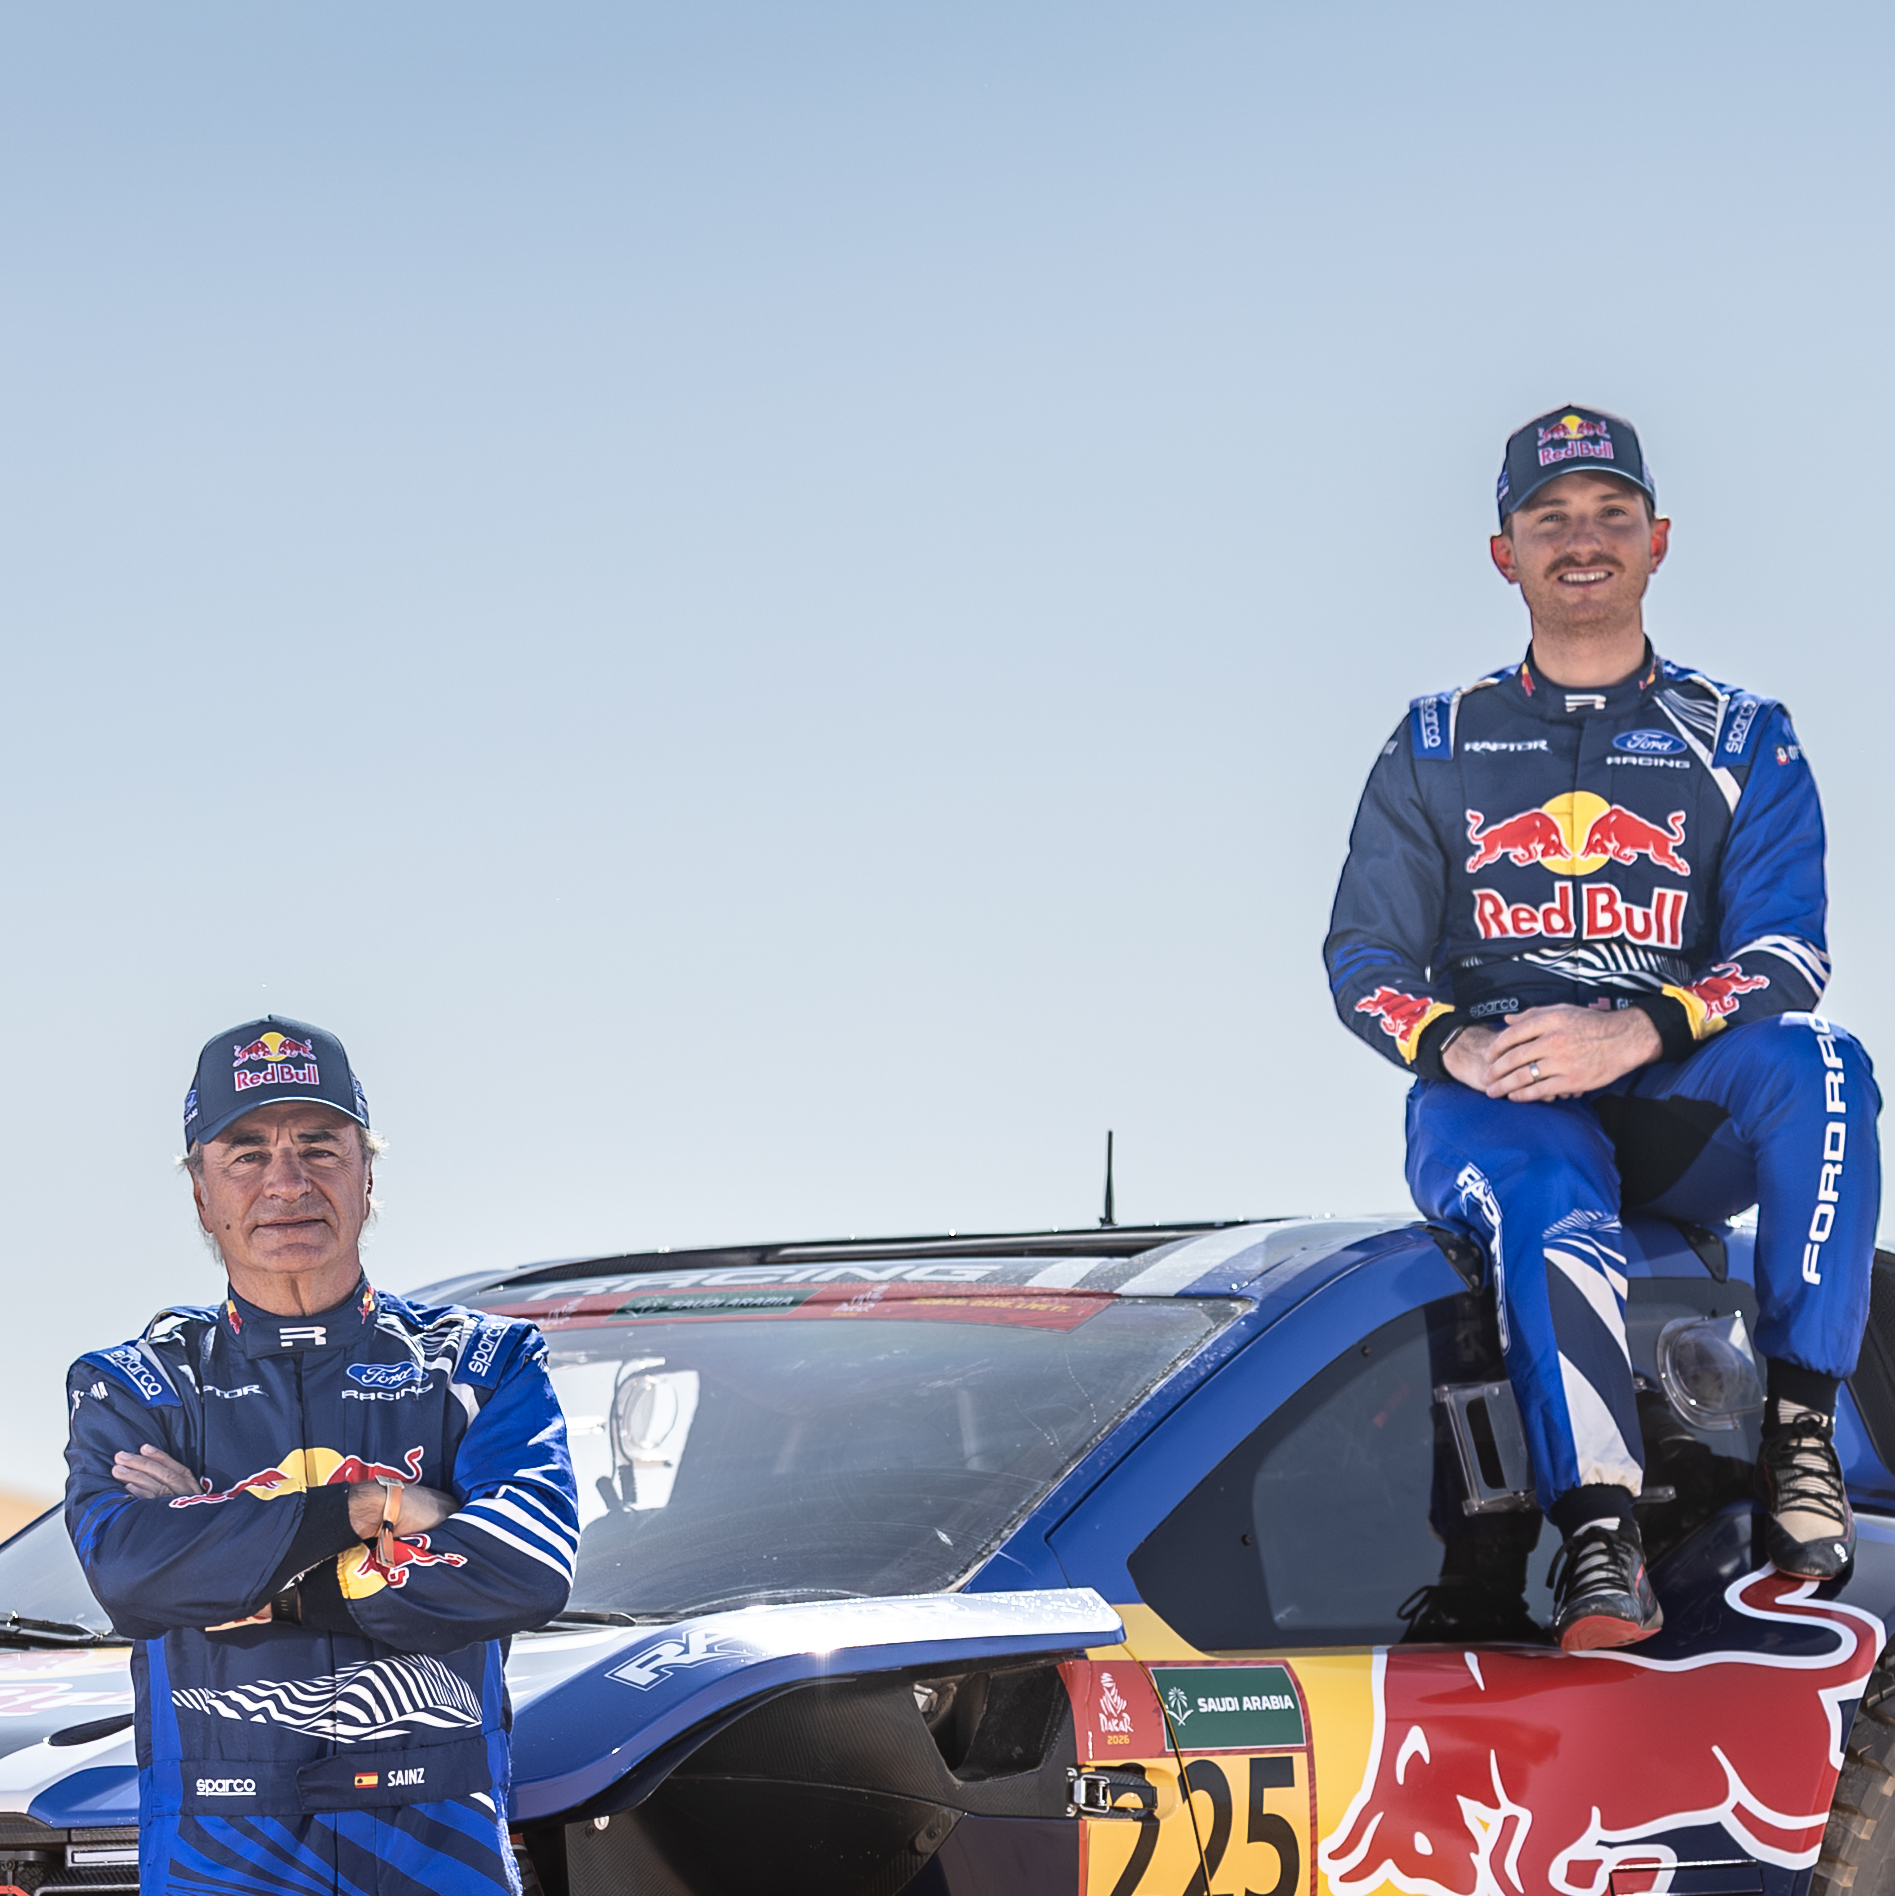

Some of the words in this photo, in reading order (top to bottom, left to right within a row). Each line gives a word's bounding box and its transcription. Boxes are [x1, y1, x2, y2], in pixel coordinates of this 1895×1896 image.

[1539, 442, 1576, 465] Red
[1578, 441, 1614, 460] Bull
[1725, 701, 1760, 755] sparco
[1464, 739, 1552, 755] RAPTOR
[1626, 733, 1673, 752] Ford
[1606, 756, 1691, 769] RACING
[1473, 881, 1576, 940] Red
[1582, 883, 1688, 950] Bull
[1469, 998, 1519, 1018] sparco
[235, 1064, 277, 1091] Red
[278, 1063, 319, 1085] Bull
[1802, 1121, 1847, 1285] FORD
[526, 1265, 1004, 1302] RACING
[468, 1322, 512, 1377] sparco
[102, 1350, 163, 1401] sparco
[361, 1365, 412, 1387] Ford
[1197, 1697, 1240, 1713] SAUDI
[1243, 1695, 1295, 1711] ARABIA
[1099, 1713, 1134, 1733] DAKAR
[1107, 1735, 1130, 1745] 2026
[196, 1778, 256, 1797] sparco
[388, 1768, 425, 1787] SAINZ
